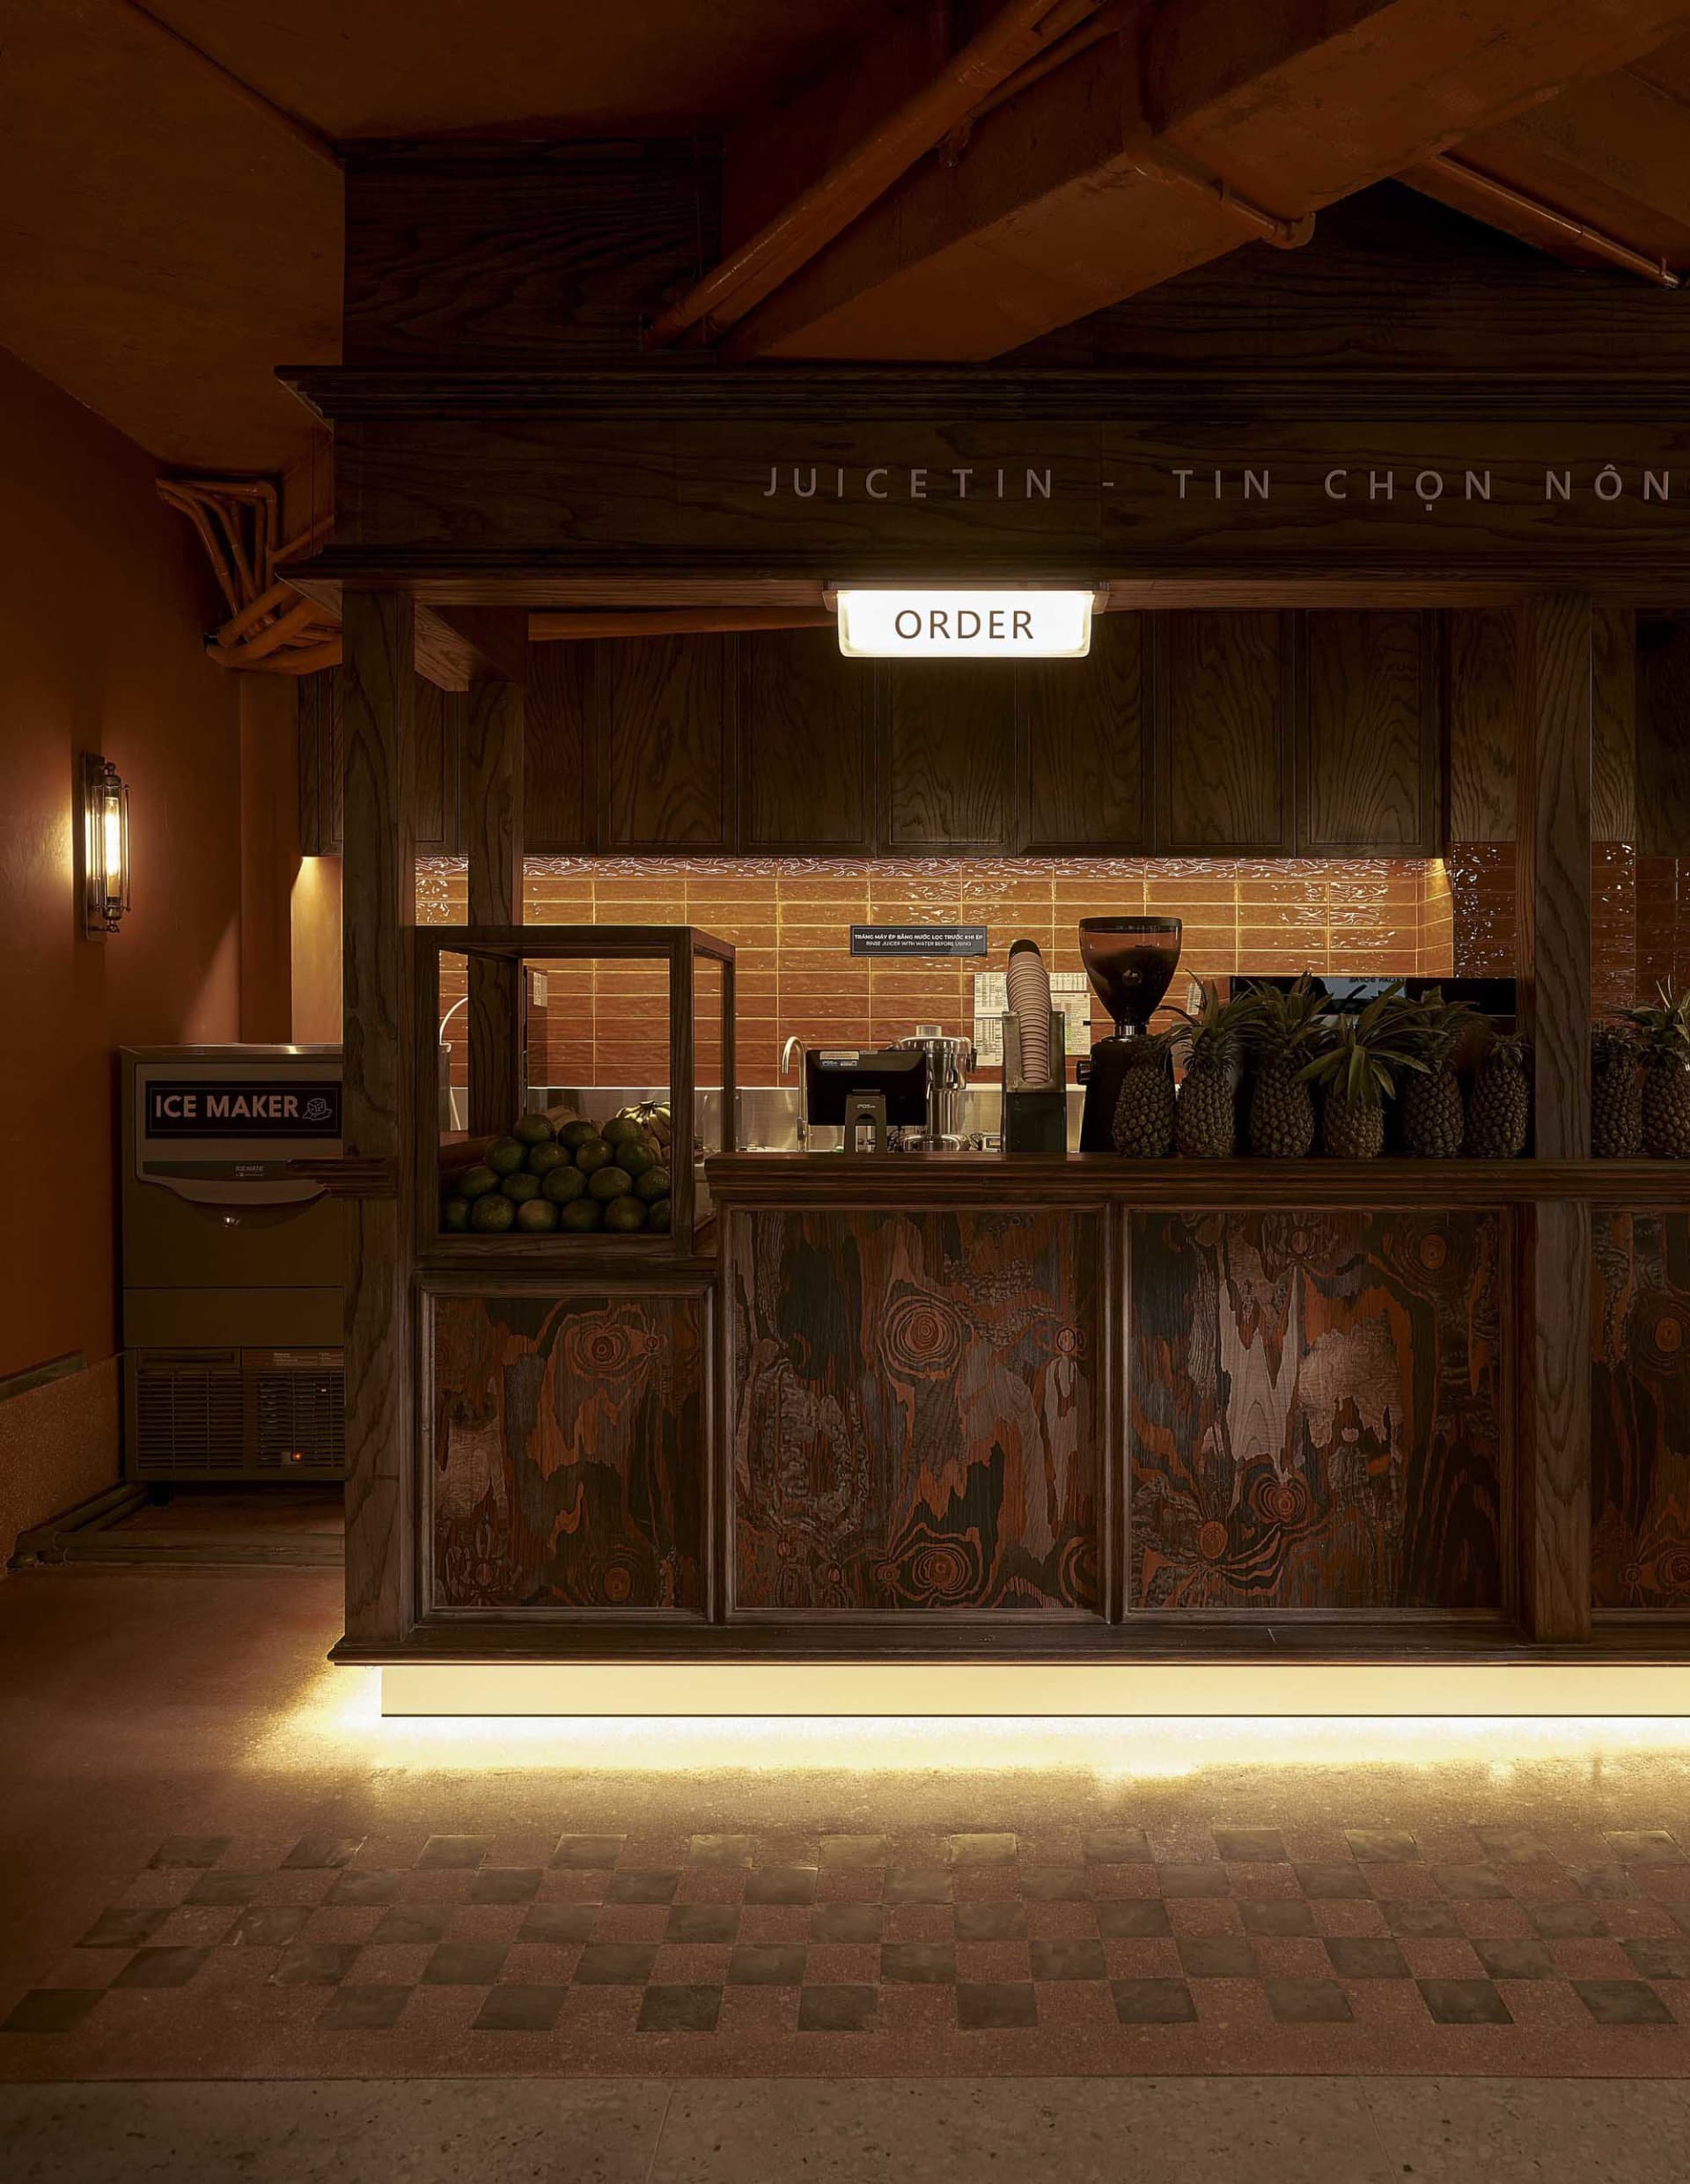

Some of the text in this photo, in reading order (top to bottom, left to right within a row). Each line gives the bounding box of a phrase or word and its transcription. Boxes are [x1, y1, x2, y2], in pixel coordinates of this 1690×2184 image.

[764, 467, 1055, 500] JUICETIN
[1173, 469, 1271, 500] TIN
[1325, 469, 1491, 511] CHỌN
[894, 609, 1034, 640] ORDER
[156, 1095, 299, 1118] ICE MAKER
